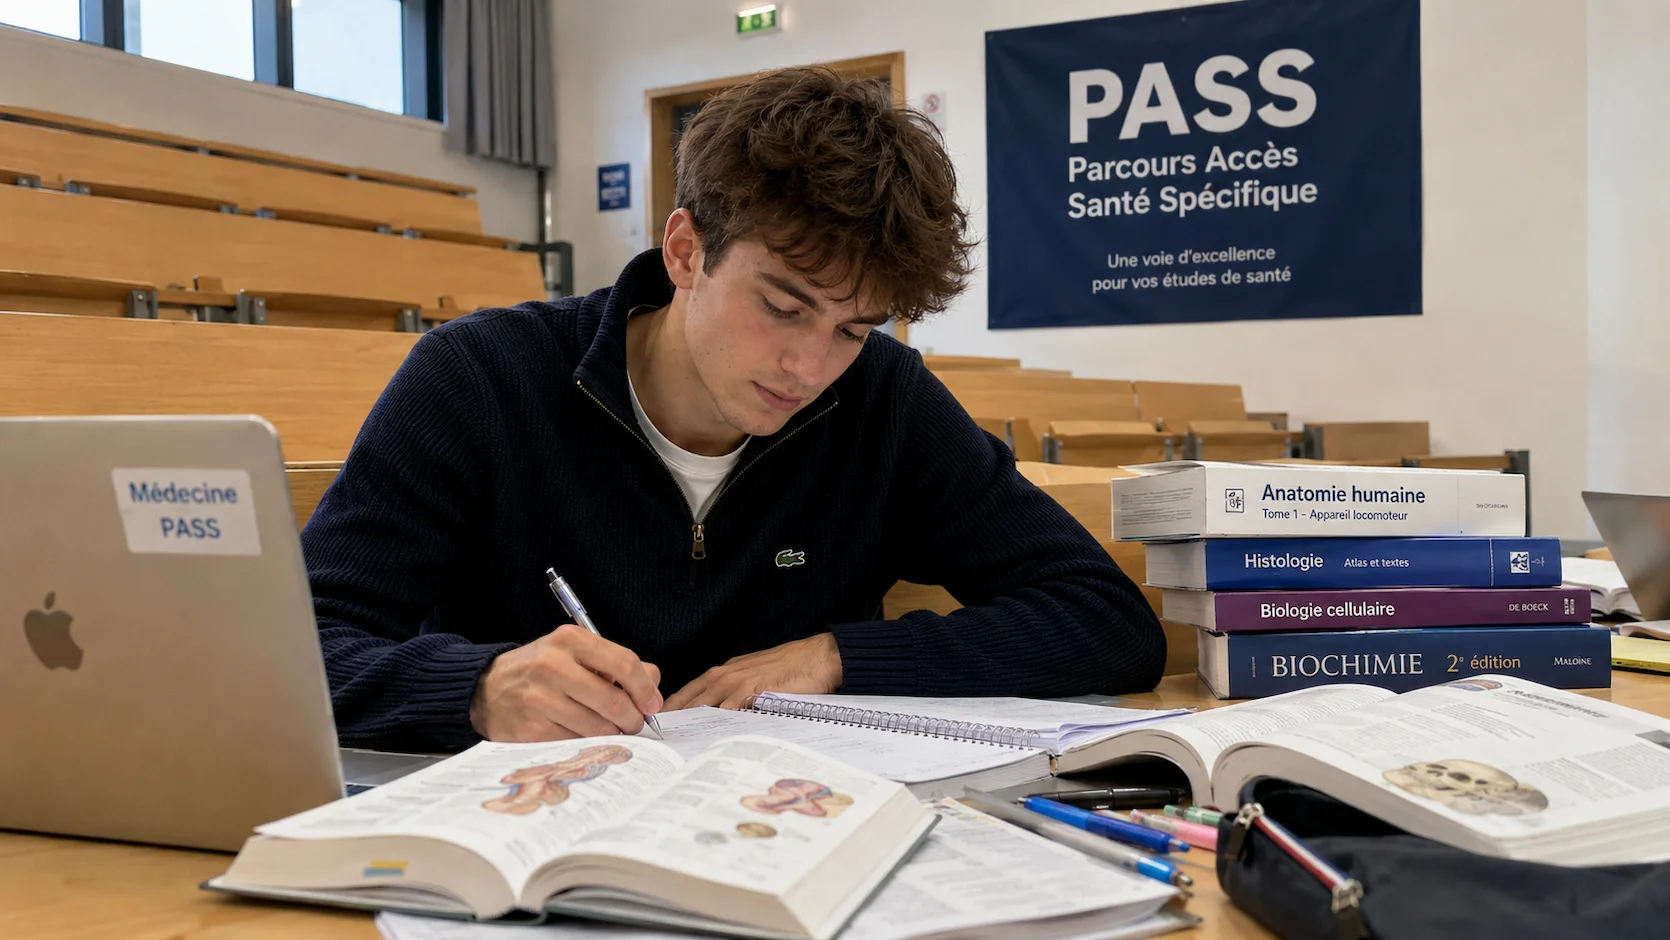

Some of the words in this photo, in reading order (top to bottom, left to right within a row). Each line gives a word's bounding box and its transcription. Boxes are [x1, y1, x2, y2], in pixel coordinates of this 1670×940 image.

[1069, 48, 1317, 144] PASS
[1068, 150, 1197, 183] Parcours
[1205, 141, 1299, 173] Accès
[1067, 188, 1151, 219] Santé
[1159, 180, 1318, 218] Spécifique
[1107, 253, 1139, 269] Une
[1142, 251, 1174, 267] voie
[1178, 246, 1276, 265] d'excellence
[1092, 277, 1128, 294] pour
[1131, 276, 1159, 289] vos
[1162, 270, 1217, 288] études
[1221, 269, 1242, 285] de
[1246, 265, 1292, 284] santé
[128, 481, 238, 505] Médecine
[1261, 483, 1347, 502] Anatomie
[1352, 485, 1426, 504] humaine
[1262, 508, 1290, 520] Tome
[1293, 508, 1298, 519] 1
[1309, 509, 1351, 522] Appareil
[1353, 509, 1409, 521] locomoteur
[160, 517, 222, 539] PASS
[1244, 553, 1324, 572] Histologie
[1343, 557, 1368, 568] Atlas
[1369, 558, 1380, 568] et
[1381, 557, 1410, 568] textes
[1260, 602, 1323, 621] Biologie
[1326, 601, 1396, 617] cellulaire
[1508, 603, 1520, 612] DE
[1521, 602, 1549, 612] BOECK
[1271, 653, 1424, 677] BIOCHIMIE
[1470, 654, 1521, 670] édition
